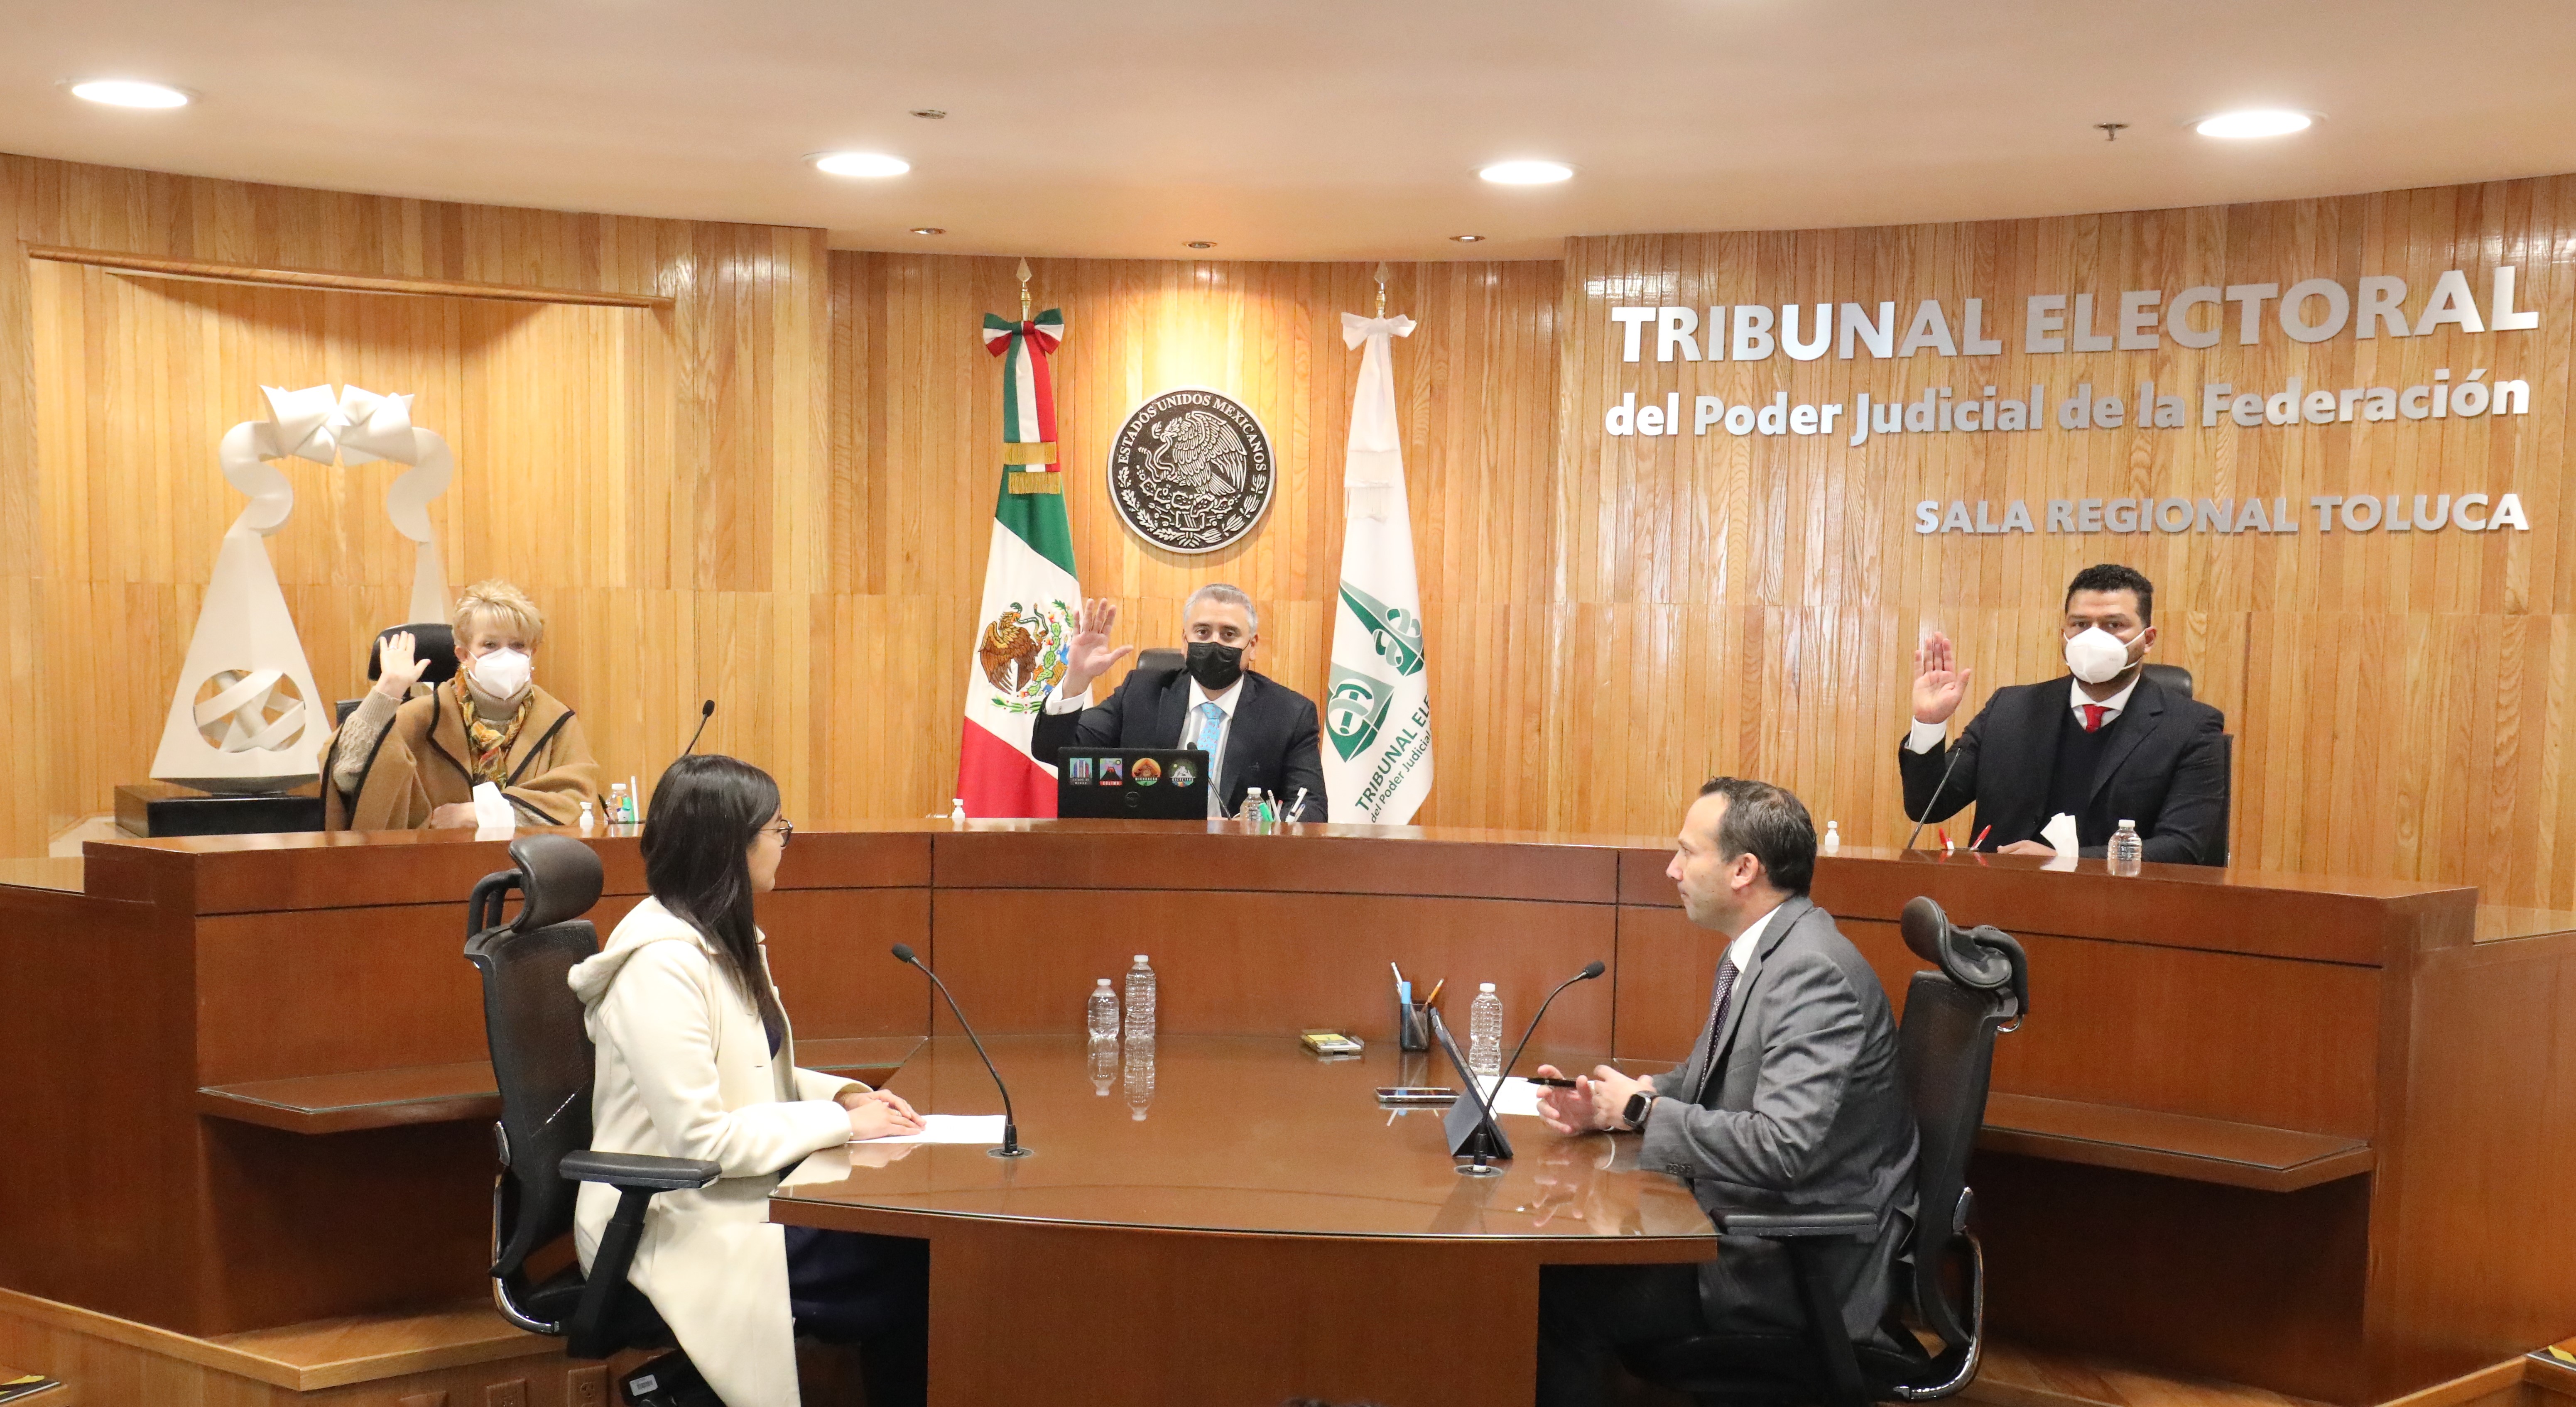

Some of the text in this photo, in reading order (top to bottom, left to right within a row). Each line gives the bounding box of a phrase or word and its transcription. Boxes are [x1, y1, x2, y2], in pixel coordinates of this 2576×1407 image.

[1612, 266, 2539, 362] TRIBUNAL ELECTORAL
[1118, 394, 1267, 472] ESTADOS UNIDOS MEXICANOS
[1605, 368, 2530, 447] del Poder Judicial de la Federación
[1915, 493, 2529, 534] SALA REGIONAL TOLUCA
[1355, 728, 1418, 811] TRIBUNAL
[1370, 730, 1431, 823] del Poder Judicial
